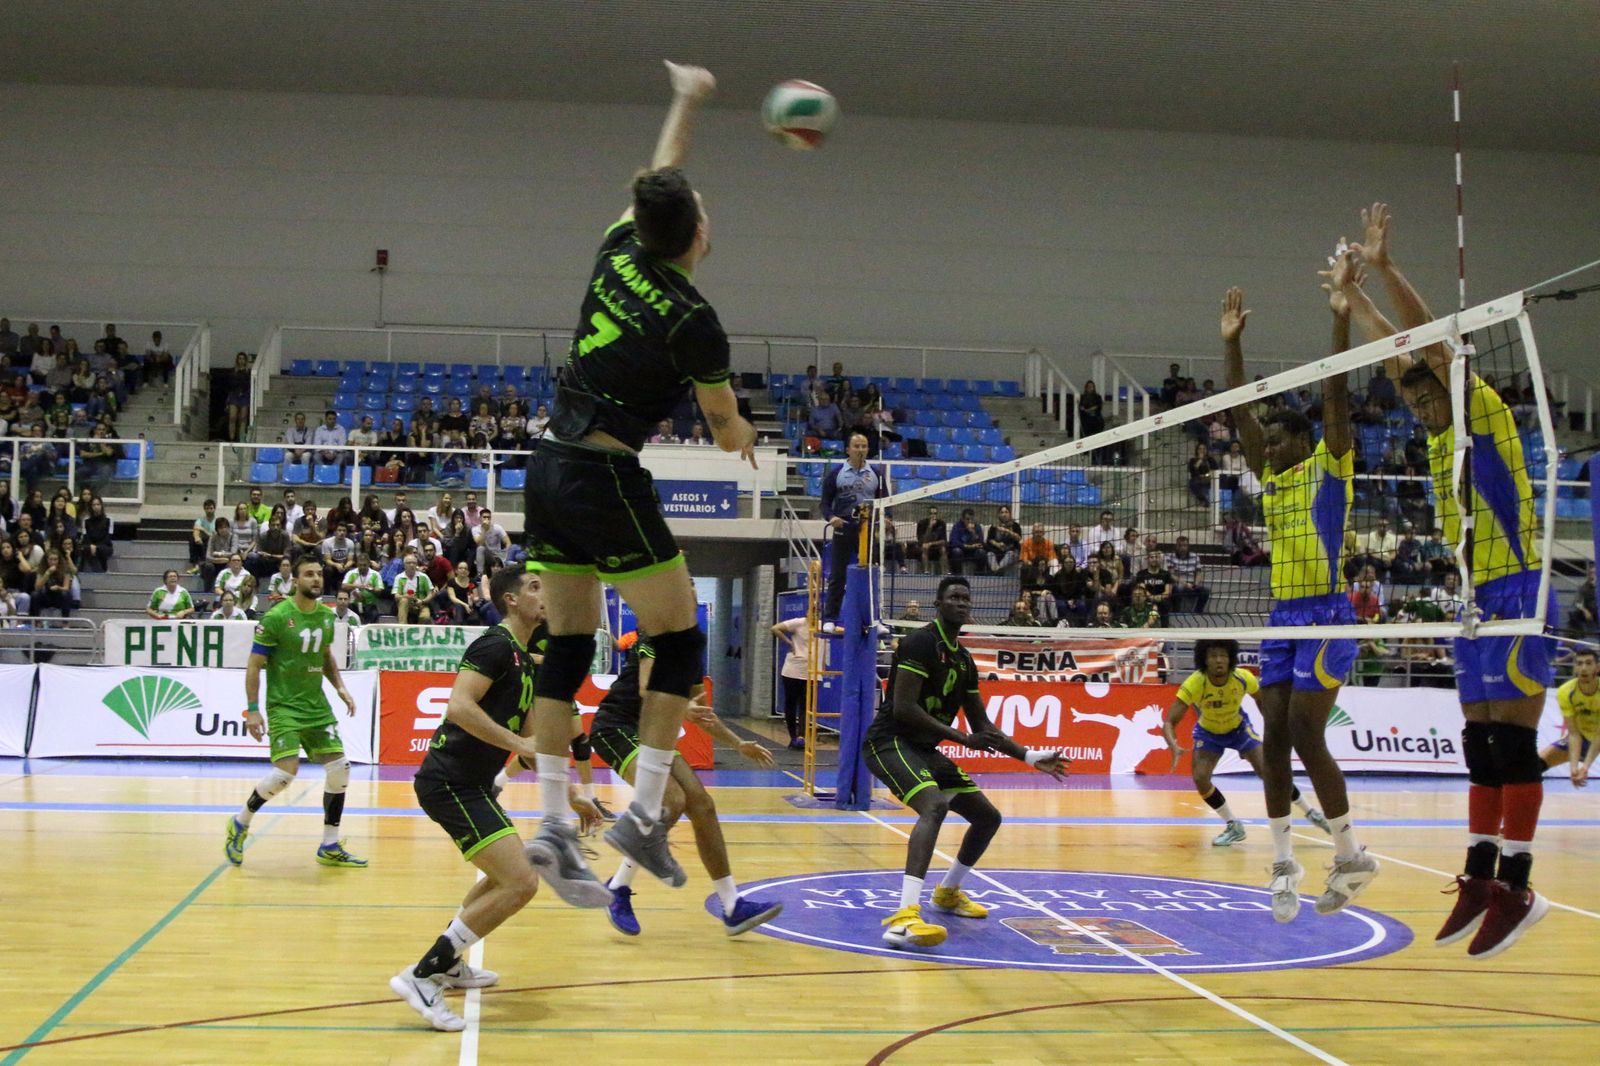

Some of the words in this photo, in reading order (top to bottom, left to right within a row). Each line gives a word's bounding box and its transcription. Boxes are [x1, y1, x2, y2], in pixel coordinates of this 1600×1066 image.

[610, 254, 673, 316] ALMANSA
[578, 311, 623, 358] 7
[664, 504, 716, 514] VESTUARIOS
[672, 492, 699, 502] ASEOS
[702, 493, 708, 502] Y
[124, 620, 224, 668] PEÑA
[299, 628, 323, 653] 11
[997, 647, 1078, 672] PEÑA
[1352, 727, 1456, 759] Unicaja
[1129, 889, 1231, 899] DE
